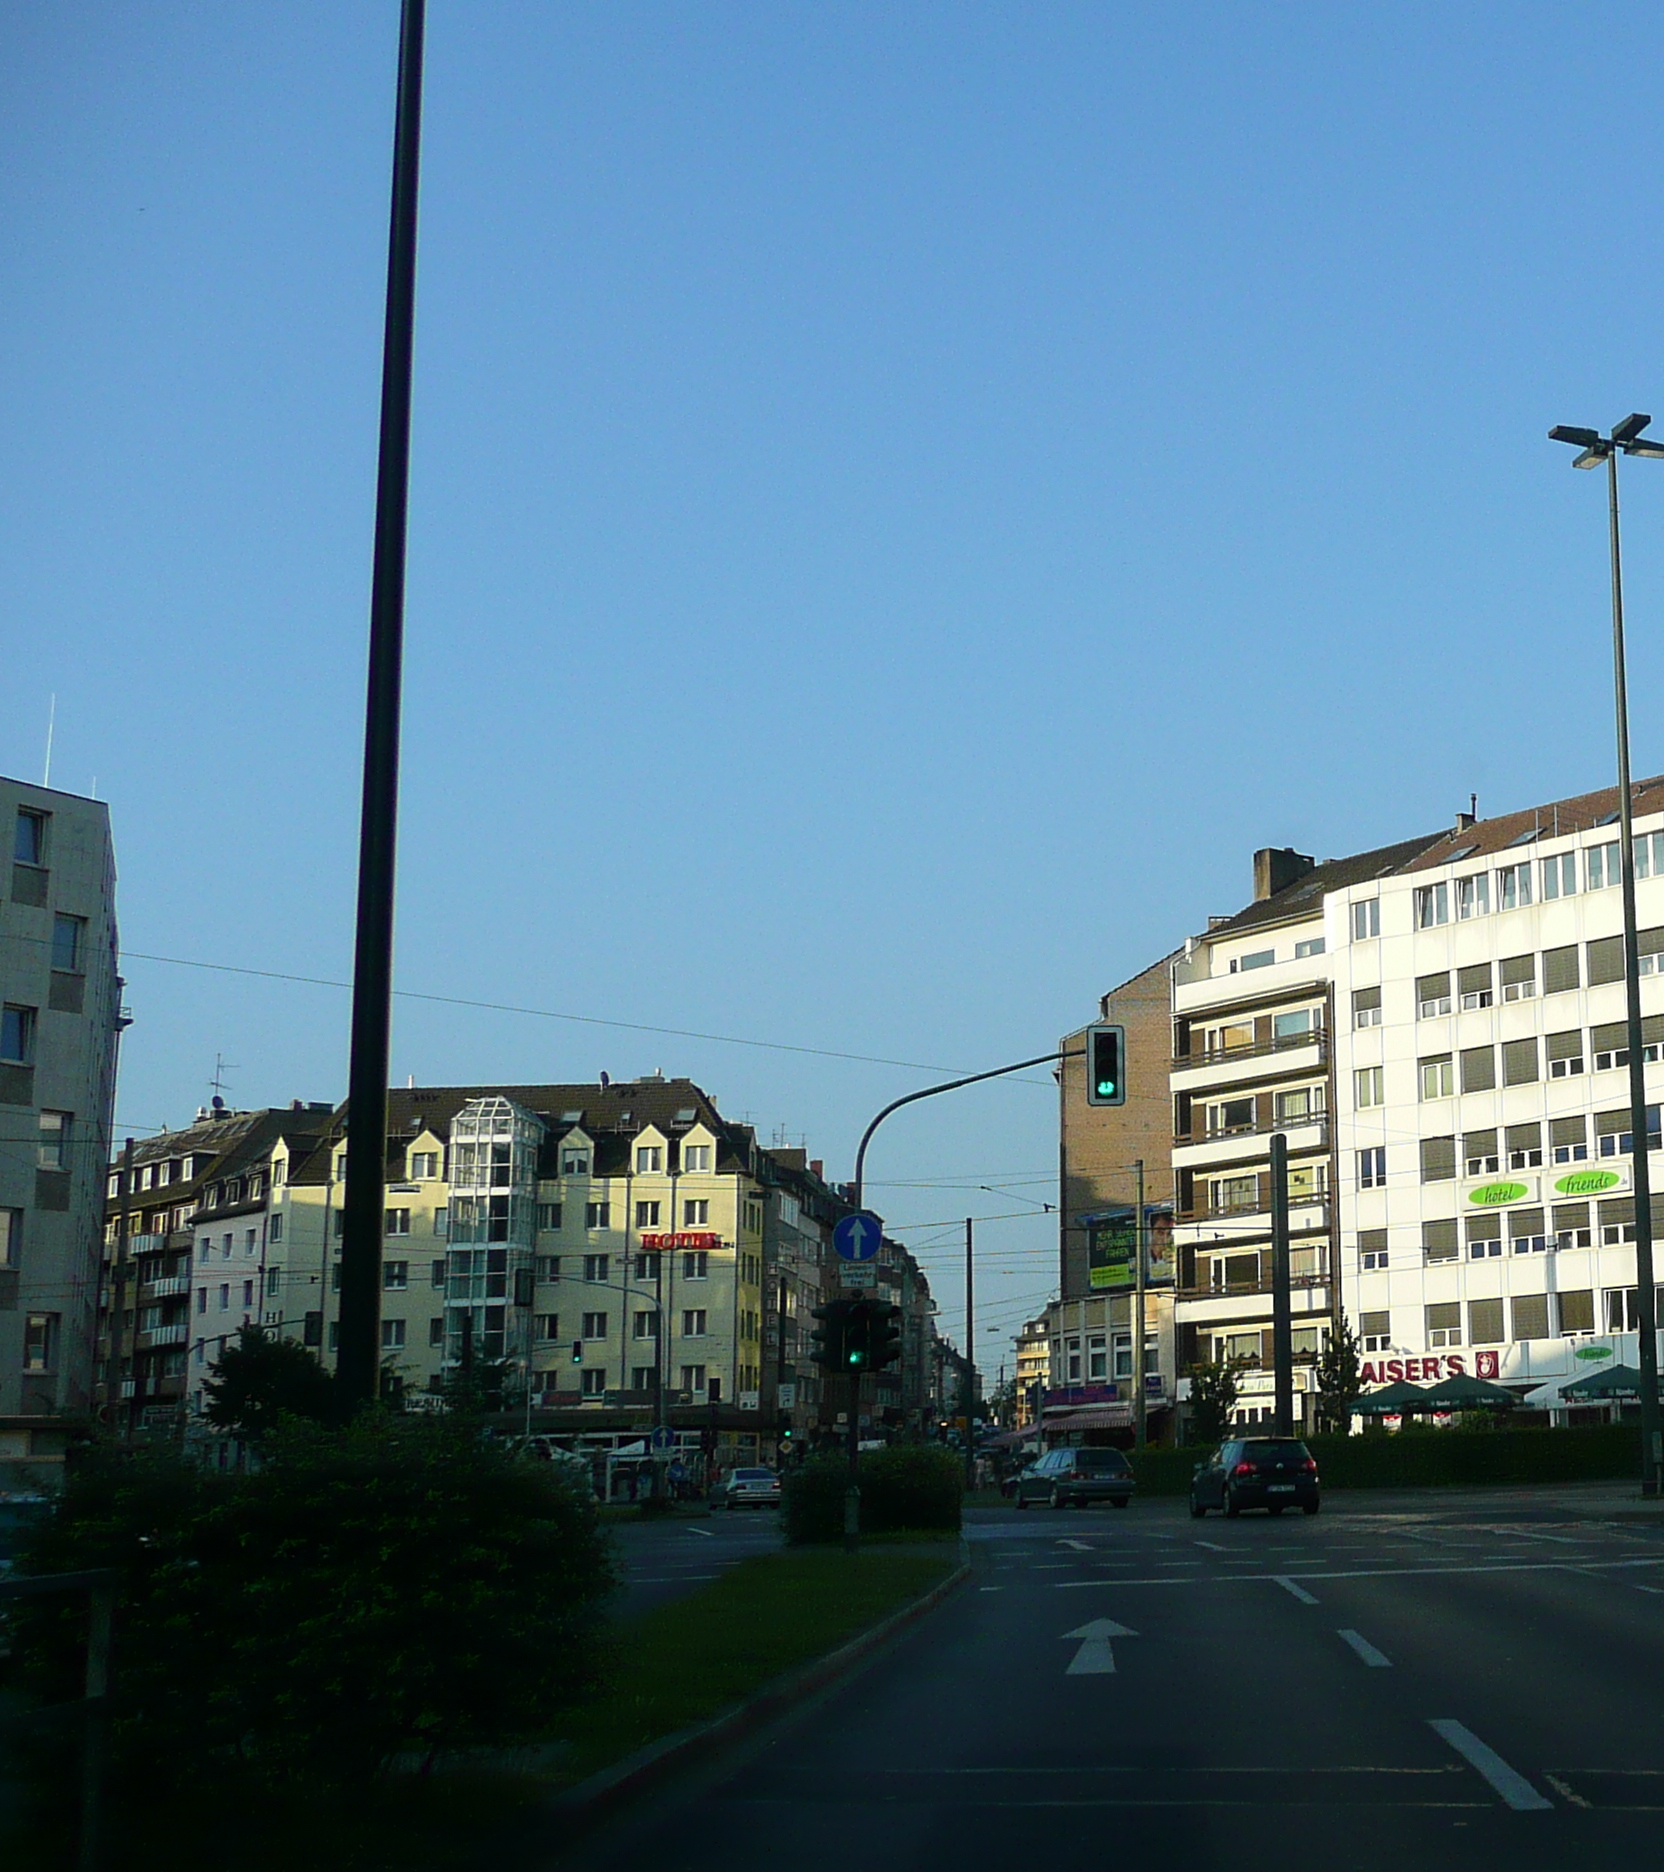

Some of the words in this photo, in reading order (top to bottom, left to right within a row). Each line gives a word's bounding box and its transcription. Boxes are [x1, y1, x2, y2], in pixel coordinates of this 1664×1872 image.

[1484, 1184, 1514, 1204] hotel
[1565, 1172, 1610, 1198] friends
[640, 1232, 724, 1250] HOTEL
[1361, 1354, 1467, 1384] AISER'S
